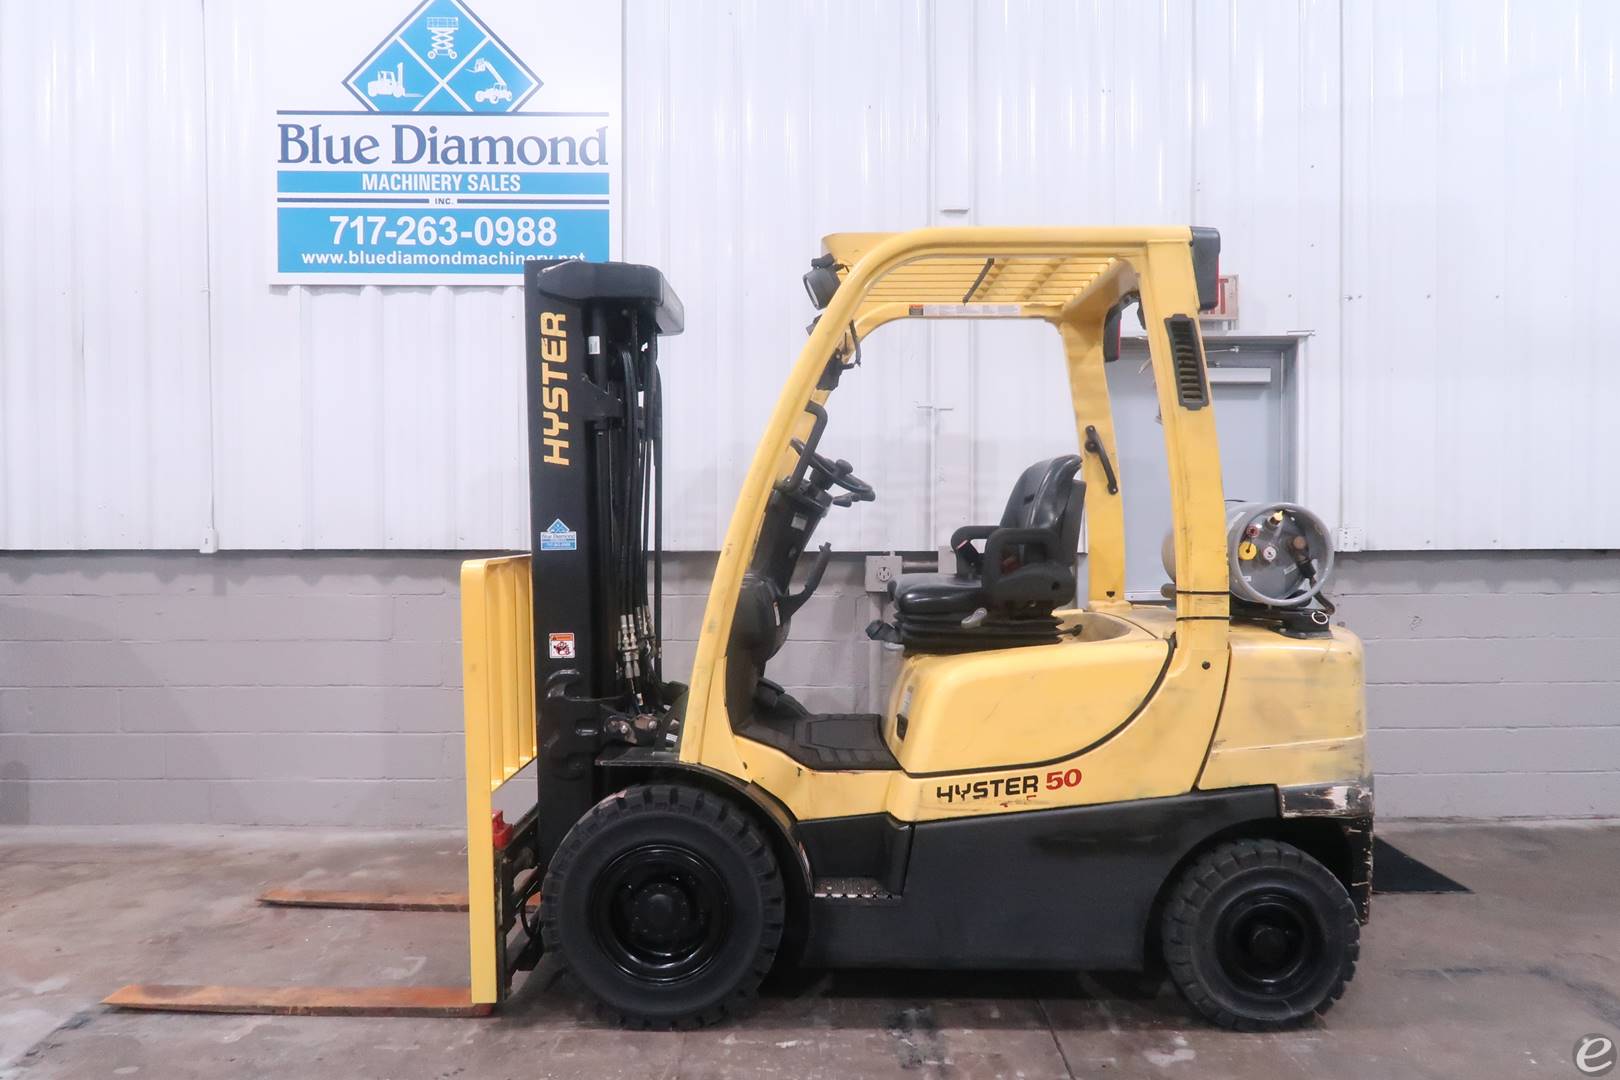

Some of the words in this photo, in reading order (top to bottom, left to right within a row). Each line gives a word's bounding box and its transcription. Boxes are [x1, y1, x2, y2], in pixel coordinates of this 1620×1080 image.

[277, 123, 381, 164] Blue
[391, 124, 609, 166] Diamond
[361, 173, 462, 192] MACHINERY
[467, 174, 522, 193] SALES
[434, 197, 454, 205] INC.
[329, 215, 558, 247] 717-263-0988
[301, 249, 586, 265] www.bluediamondmachinernt
[540, 311, 570, 466] HYSTER
[936, 775, 1038, 802] HYSTER
[1045, 768, 1083, 791] 50
